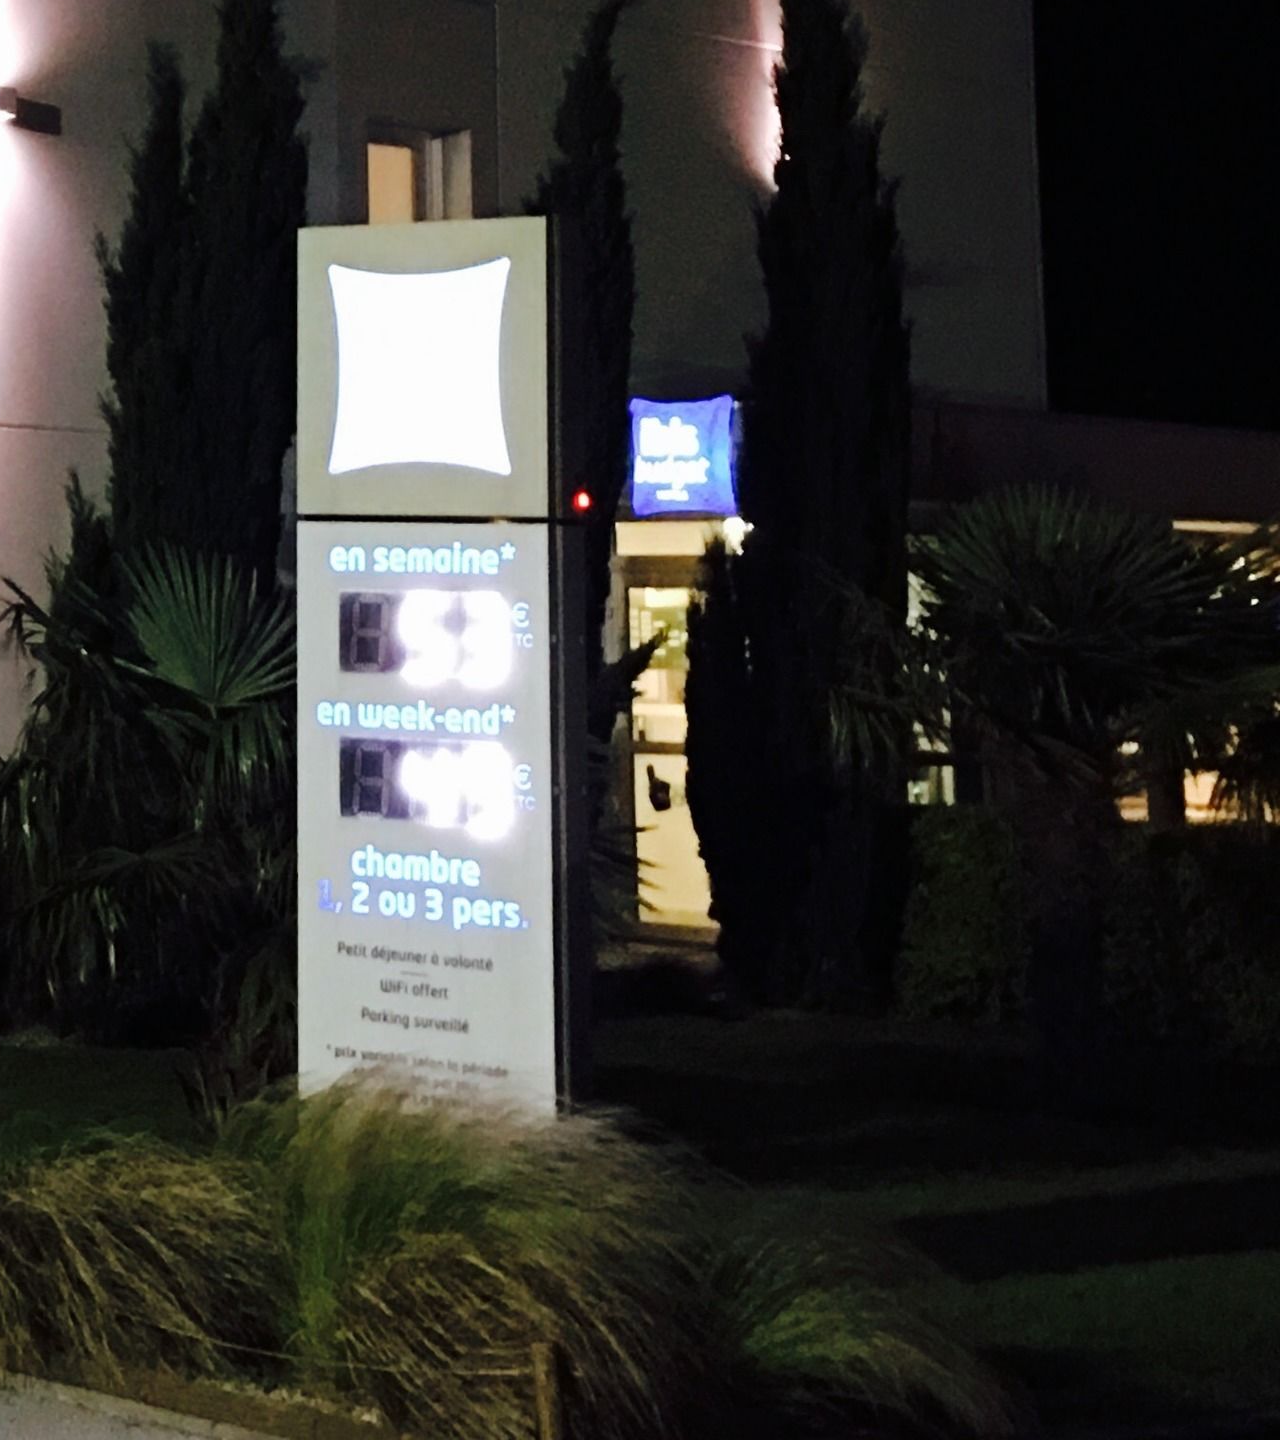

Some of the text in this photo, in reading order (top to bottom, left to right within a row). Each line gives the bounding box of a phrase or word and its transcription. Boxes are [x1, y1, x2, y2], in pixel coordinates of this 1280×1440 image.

[329, 546, 366, 572] en
[317, 701, 351, 726] en
[351, 844, 481, 887] chambre
[351, 881, 370, 914] 2
[378, 890, 416, 919] ou
[424, 888, 444, 921] 3
[452, 896, 529, 930] pers.
[337, 941, 367, 957] Petit
[371, 945, 427, 964] déjeuner
[443, 955, 494, 972] volonté
[380, 978, 449, 999] WiFi offert
[361, 1006, 469, 1034] Parking surveillé
